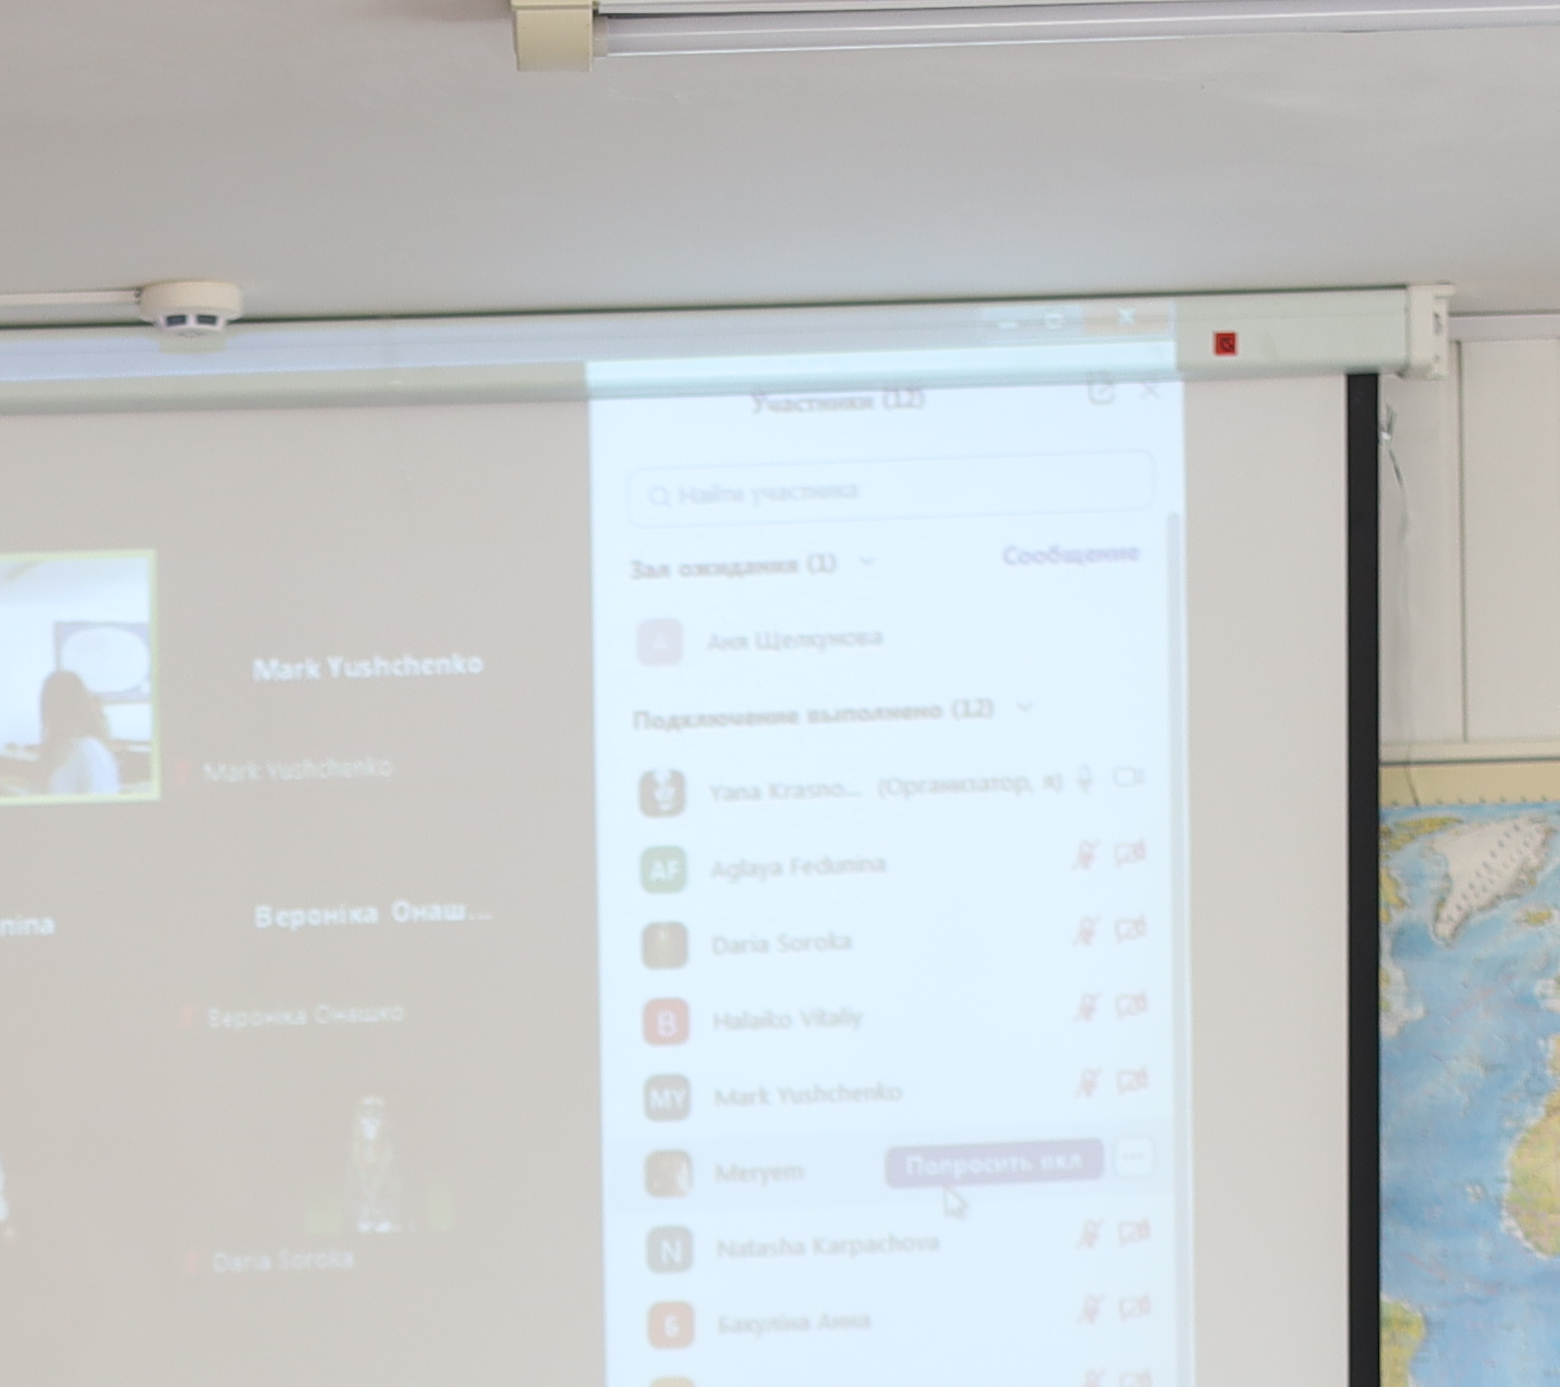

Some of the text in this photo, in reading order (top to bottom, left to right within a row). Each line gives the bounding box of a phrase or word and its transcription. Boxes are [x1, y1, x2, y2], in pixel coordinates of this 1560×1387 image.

[252, 652, 484, 681] Mark Yushchenko
[253, 903, 380, 931] Вероніка
